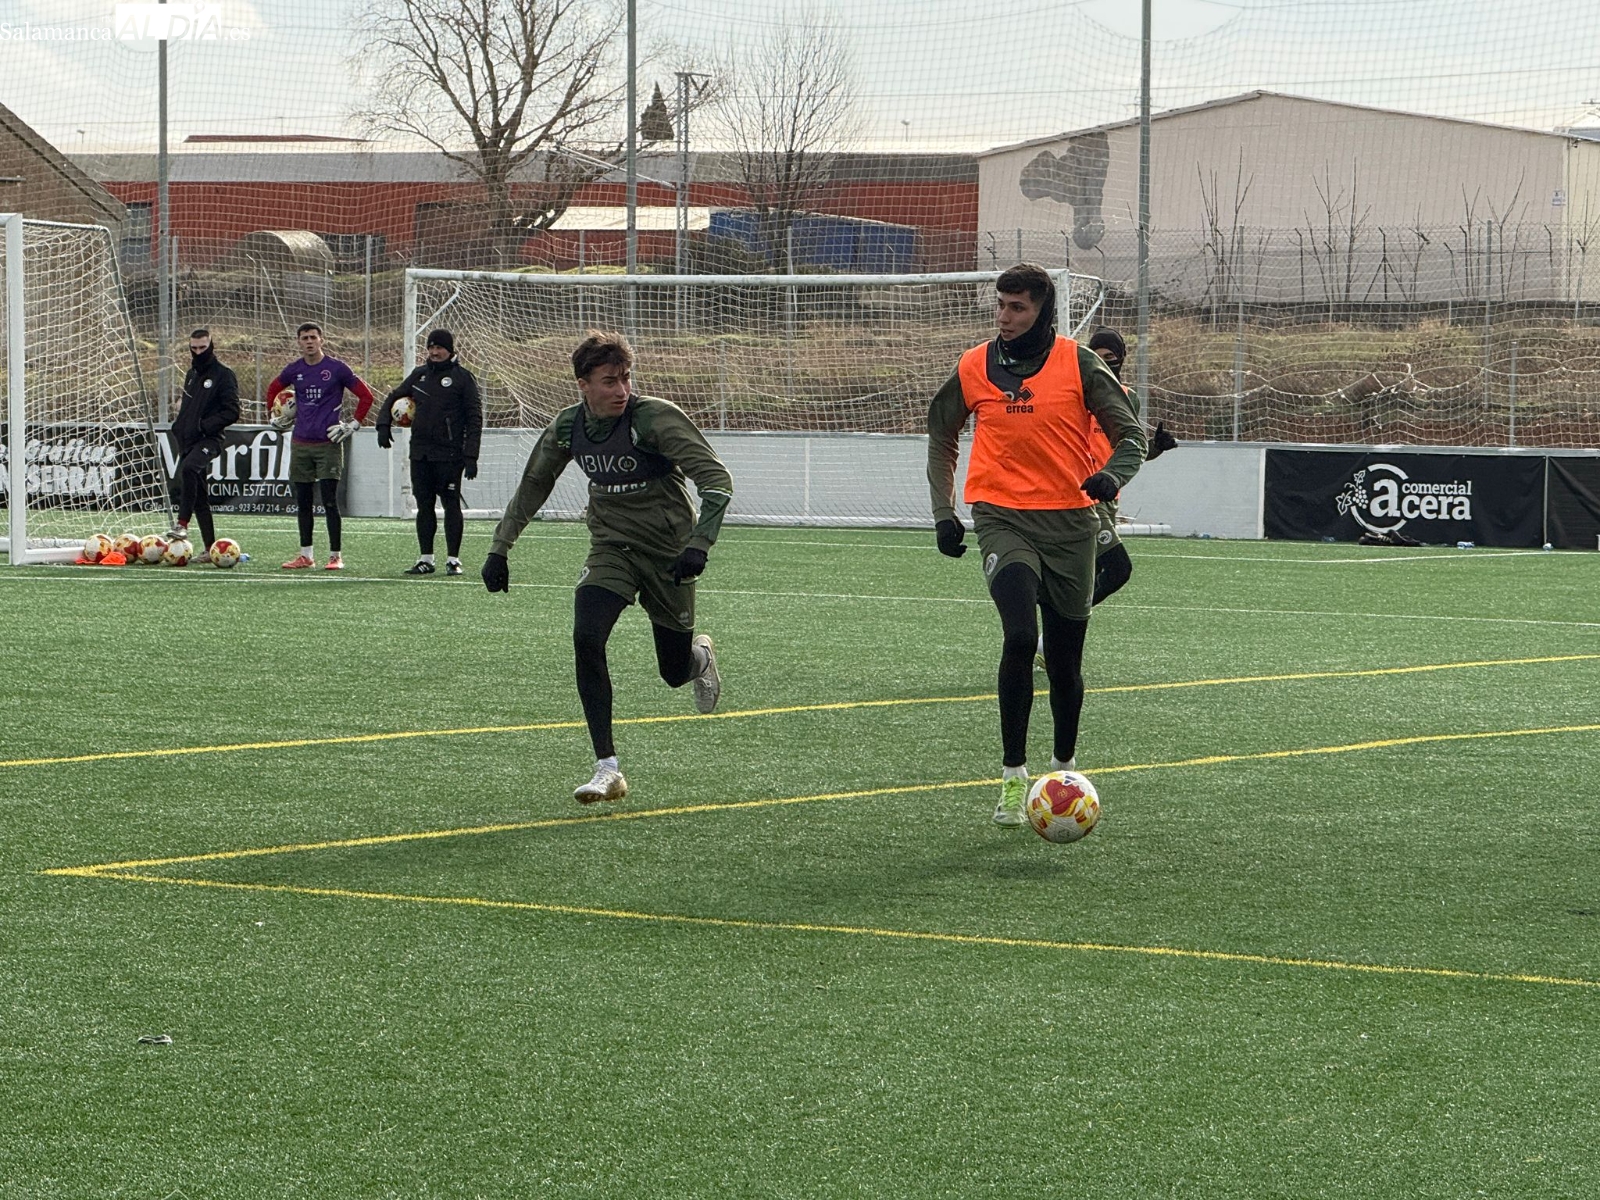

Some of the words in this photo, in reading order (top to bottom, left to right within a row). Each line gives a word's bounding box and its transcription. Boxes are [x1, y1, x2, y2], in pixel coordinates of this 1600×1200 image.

[208, 483, 240, 497] ICINA
[243, 481, 293, 498] ESTÉTICA
[1401, 481, 1472, 496] comercial
[239, 504, 250, 512] 923
[266, 504, 280, 512] 214
